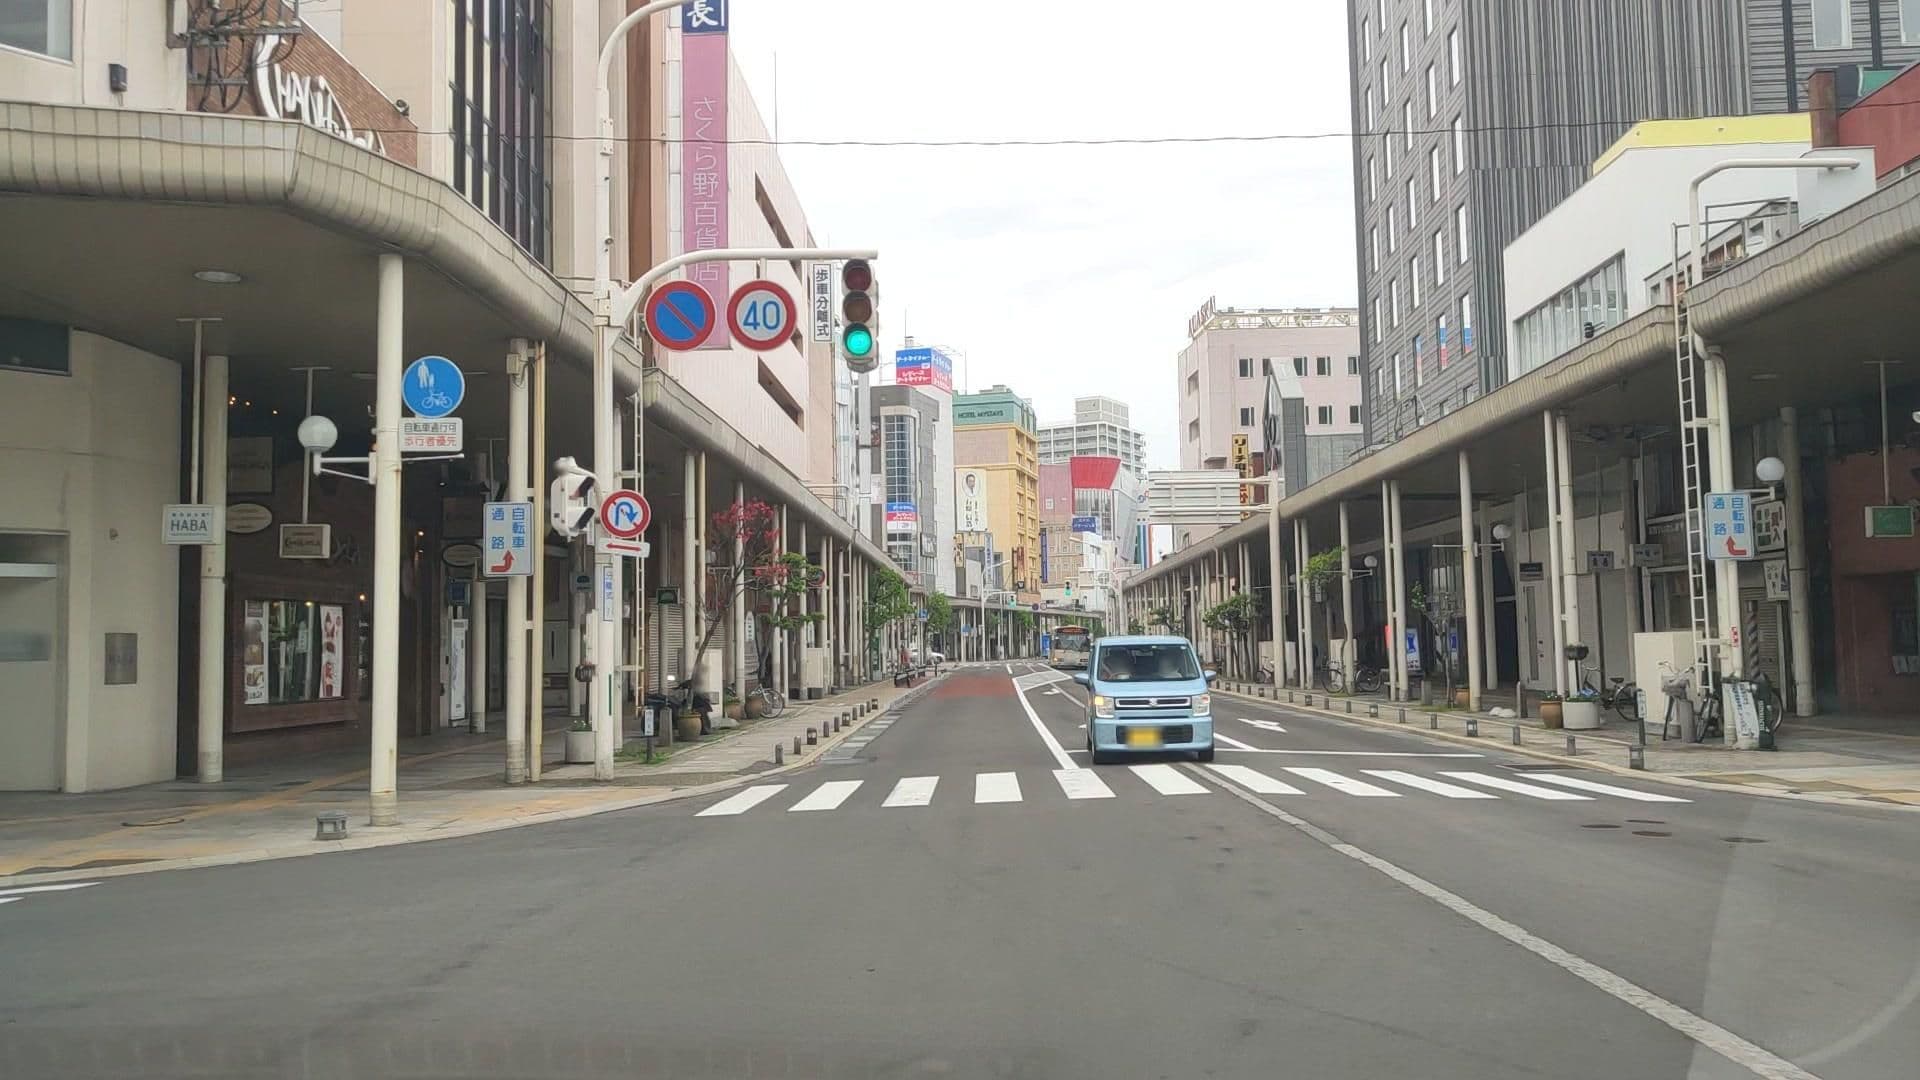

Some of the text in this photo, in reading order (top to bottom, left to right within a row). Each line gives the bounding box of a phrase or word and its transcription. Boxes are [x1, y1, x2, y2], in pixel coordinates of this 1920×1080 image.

[743, 300, 780, 330] 40
[816, 269, 829, 336] 歩車分離式
[404, 423, 456, 433] 自転車通行可
[170, 519, 208, 532] HABA
[491, 507, 504, 549] 通路
[512, 507, 525, 548] 自転車
[1732, 497, 1745, 534] 自転車
